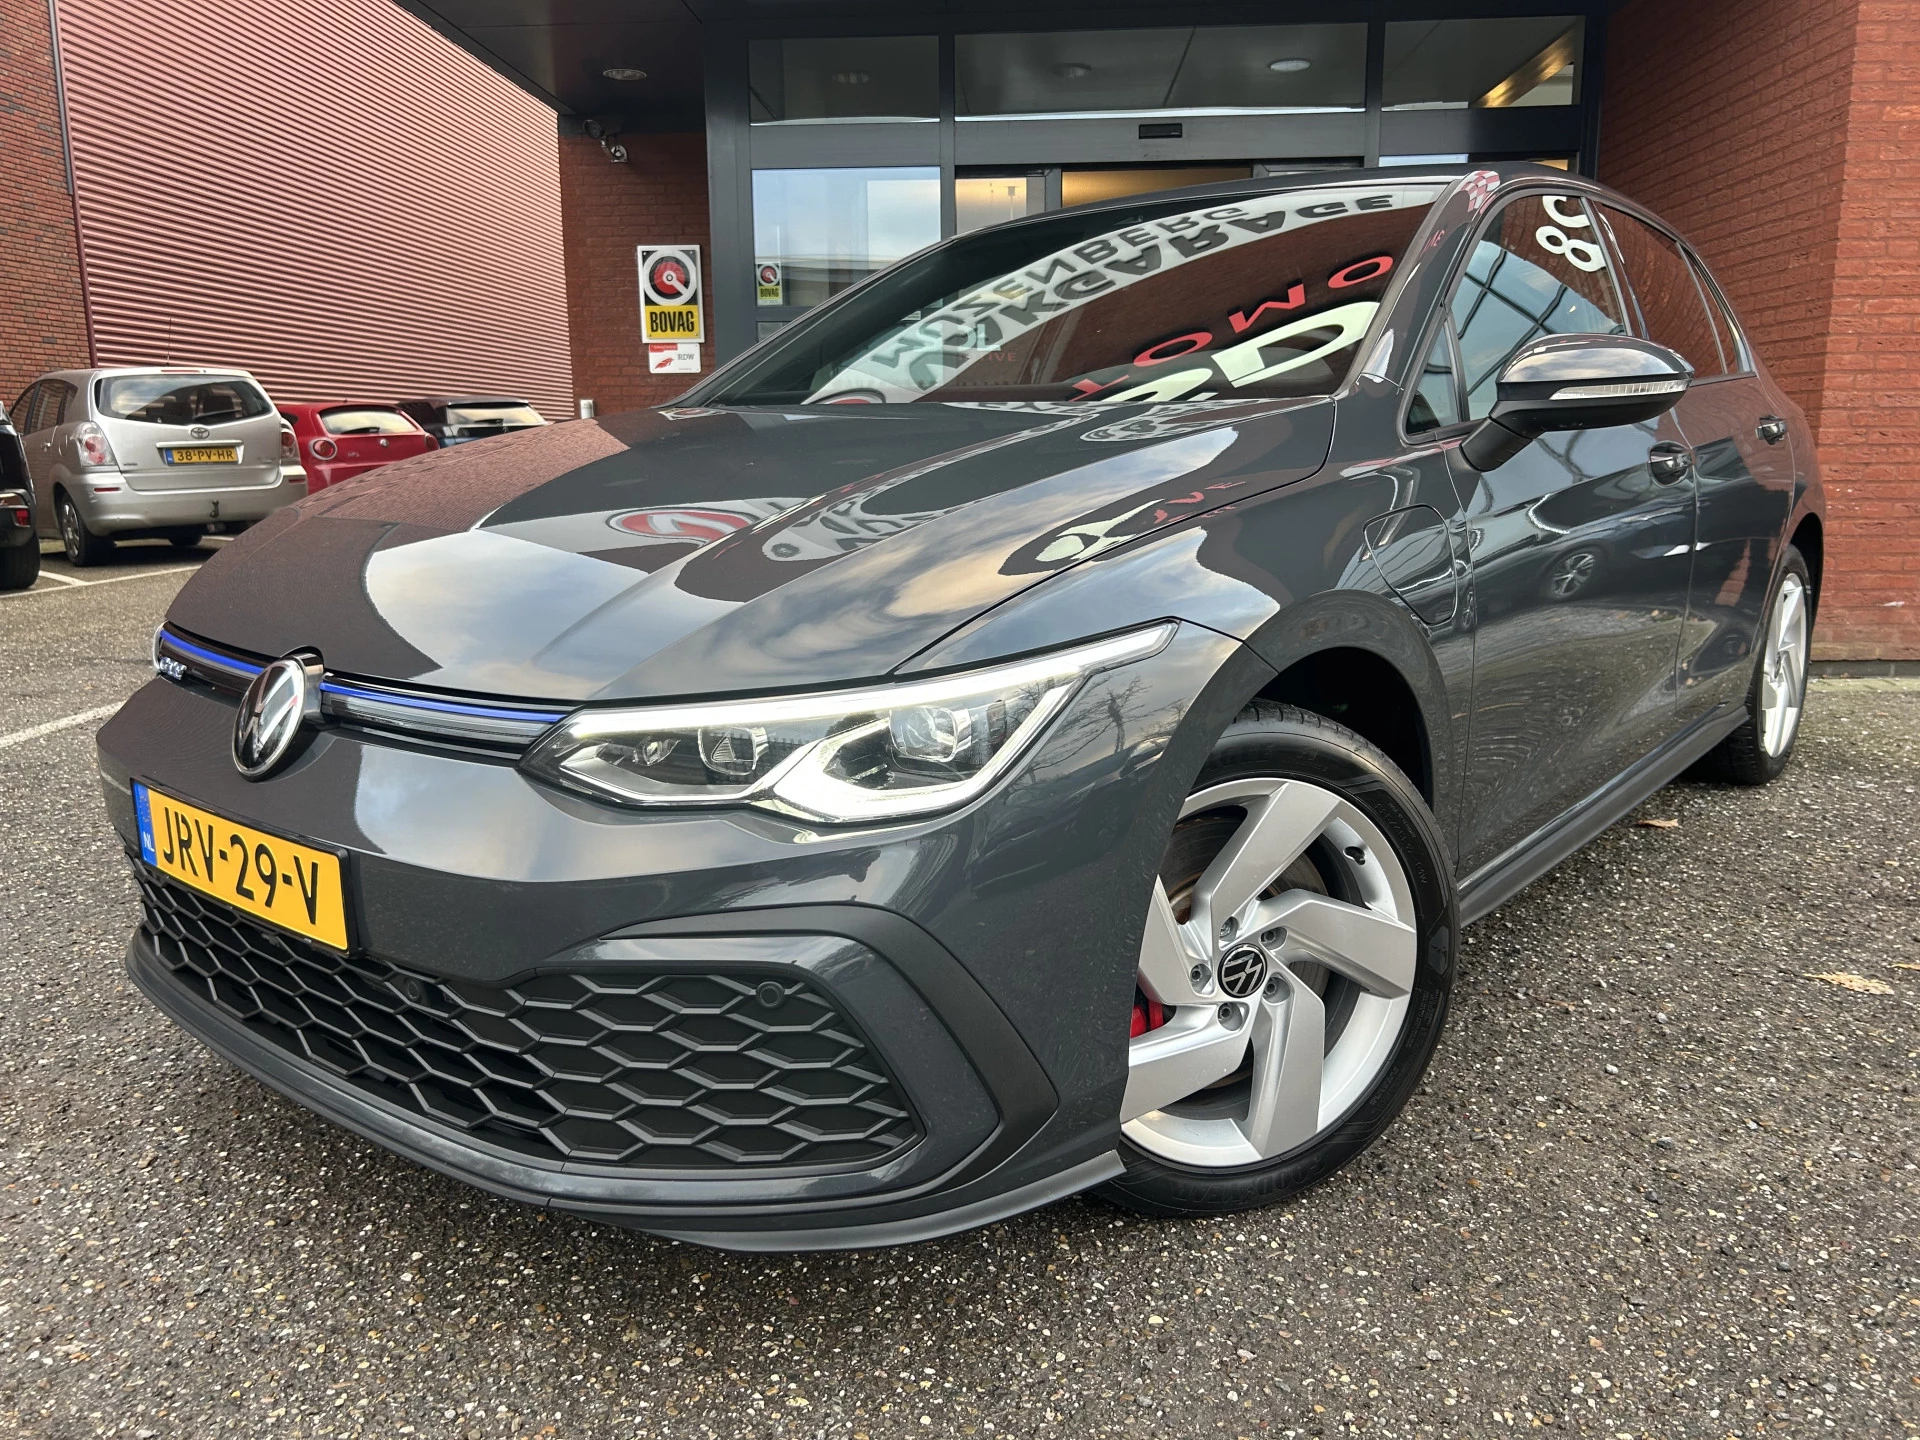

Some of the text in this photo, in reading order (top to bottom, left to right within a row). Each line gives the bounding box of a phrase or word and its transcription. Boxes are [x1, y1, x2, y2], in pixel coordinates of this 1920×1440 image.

[760, 288, 779, 298] BOVAG
[650, 311, 695, 333] BOVAG
[677, 353, 694, 361] RDW
[177, 449, 234, 461] 38-PV-HR
[143, 831, 155, 852] NL
[163, 806, 319, 925] JRV-29-V
